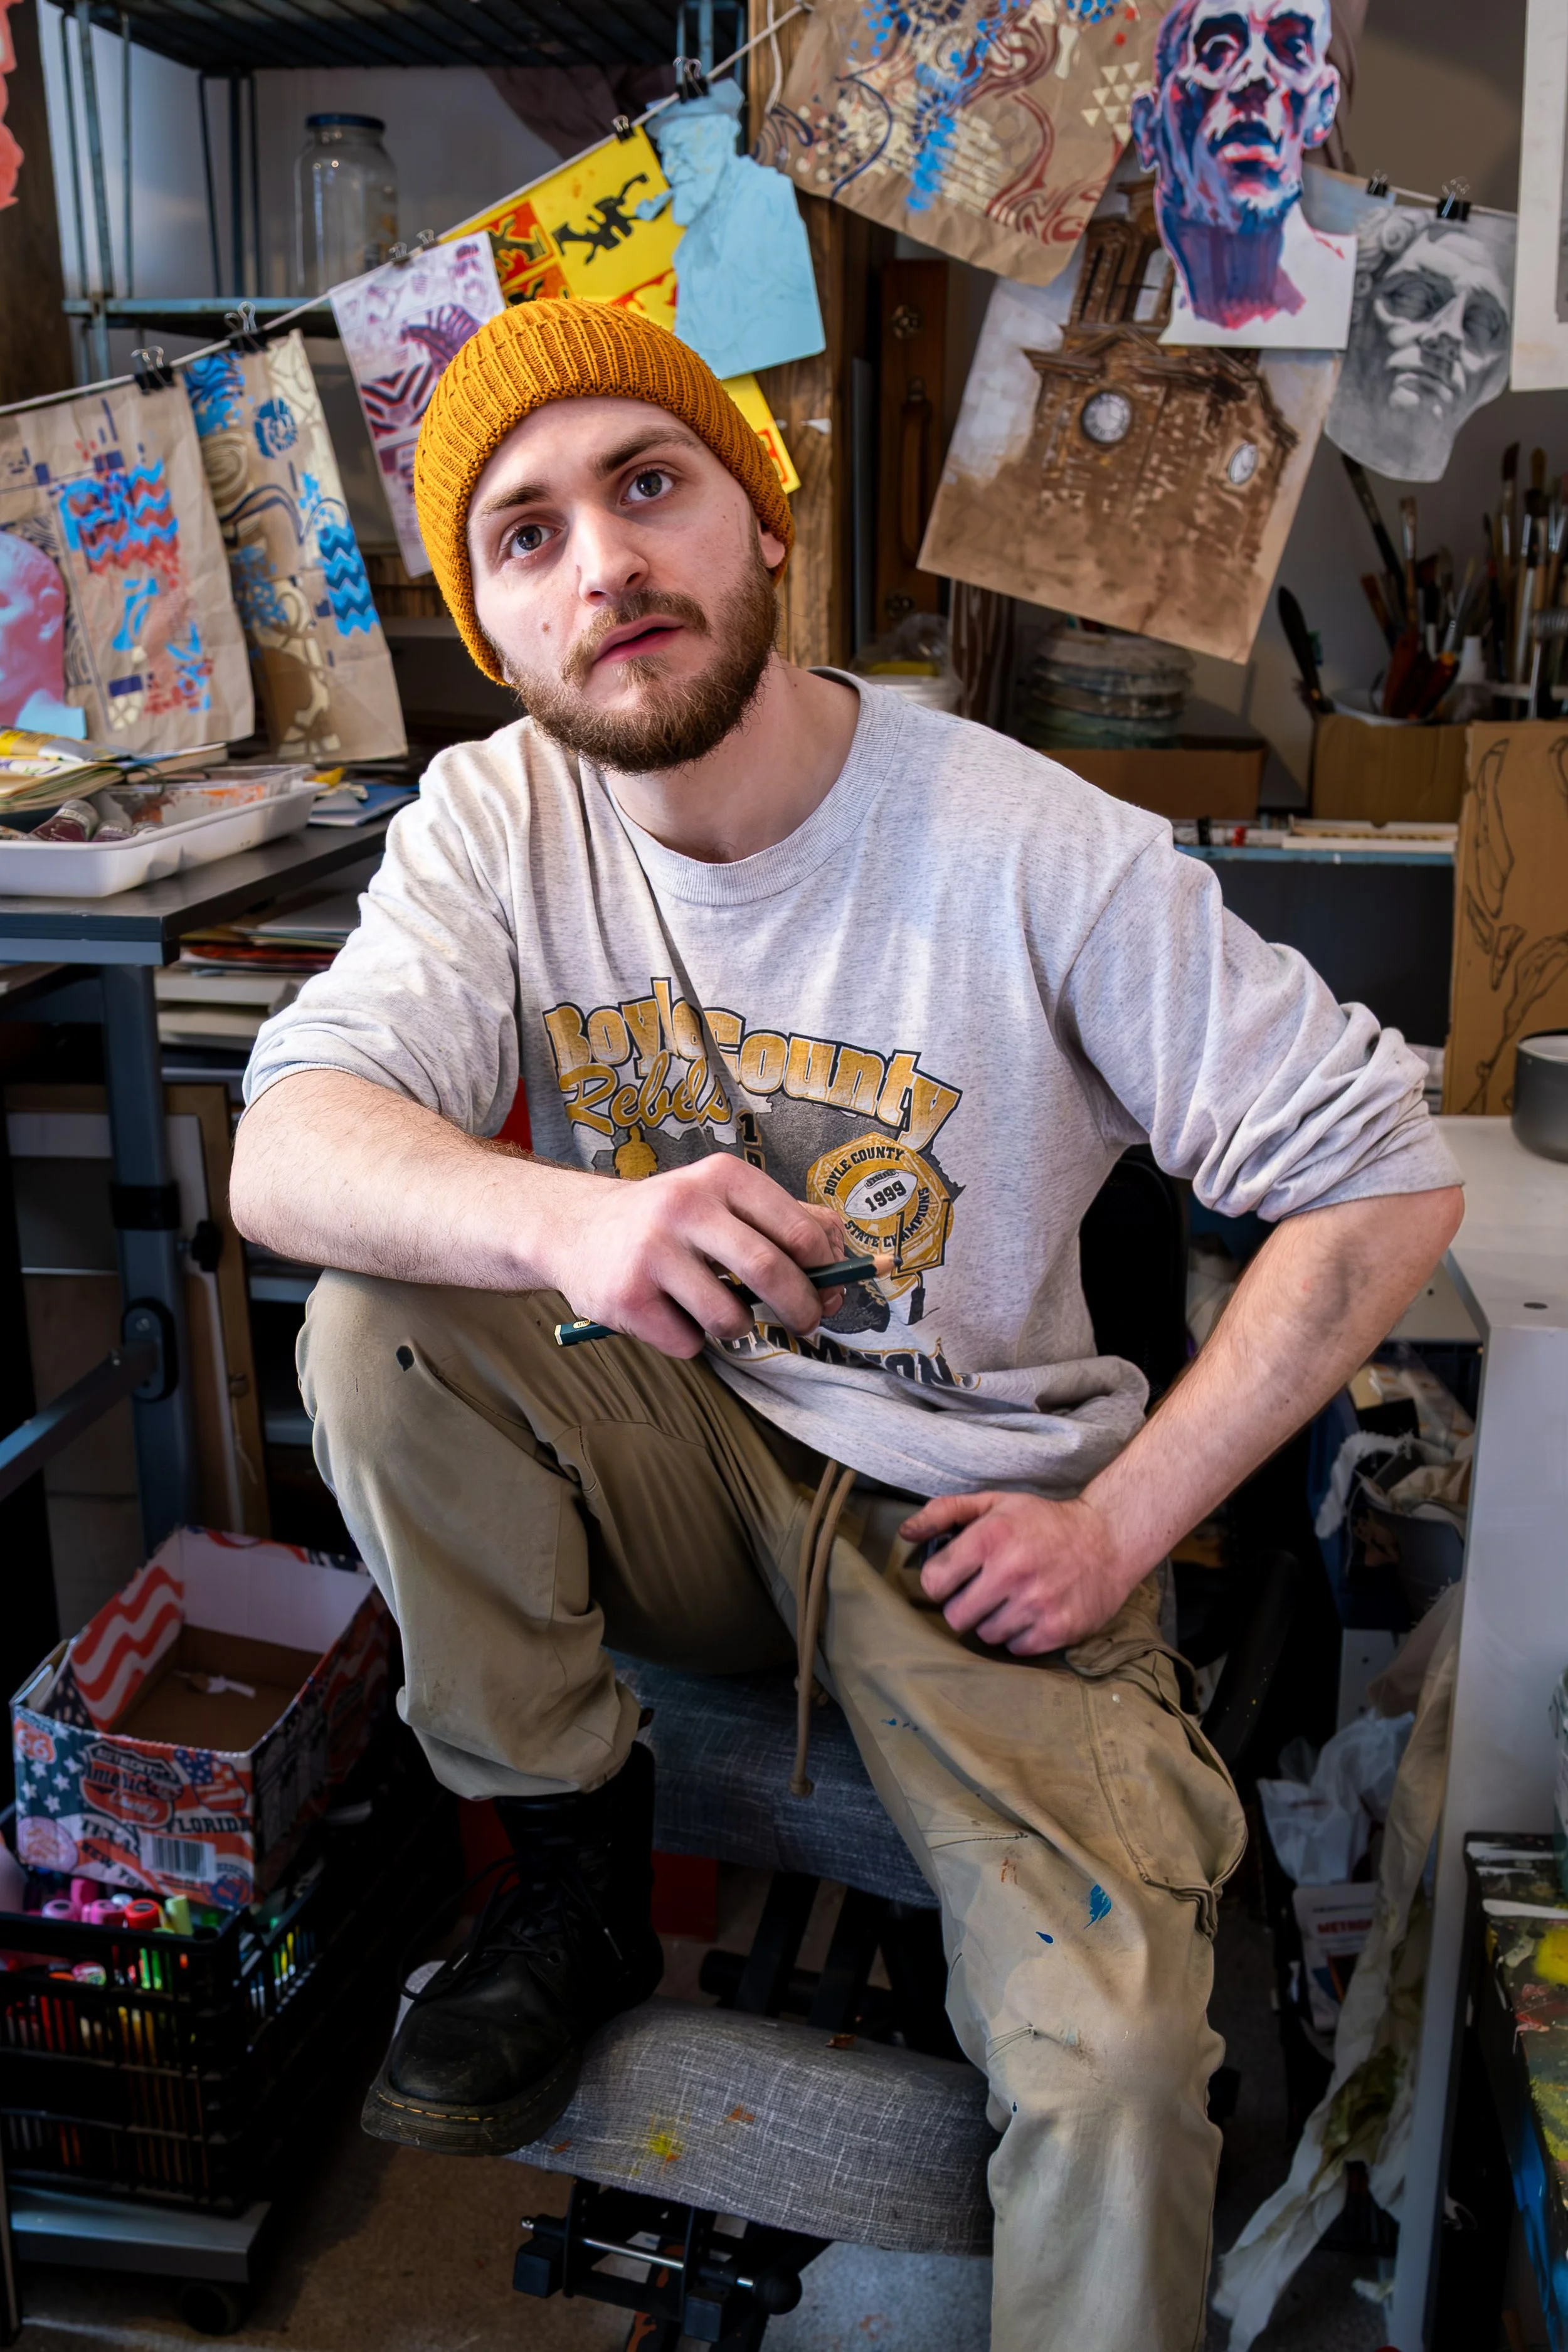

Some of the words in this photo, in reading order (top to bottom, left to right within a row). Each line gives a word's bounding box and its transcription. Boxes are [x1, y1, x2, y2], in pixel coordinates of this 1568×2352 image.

[542, 977, 707, 1079] Boyle
[703, 1007, 963, 1151] County
[559, 1049, 733, 1136] Rebels
[824, 1159, 852, 1196] BOYLE
[850, 1147, 905, 1164] COUNTY
[865, 1180, 907, 1212] 1999
[845, 1219, 879, 1248] STATE
[883, 1187, 930, 1248] CHAMPIONS
[17, 1728, 49, 1759] 66
